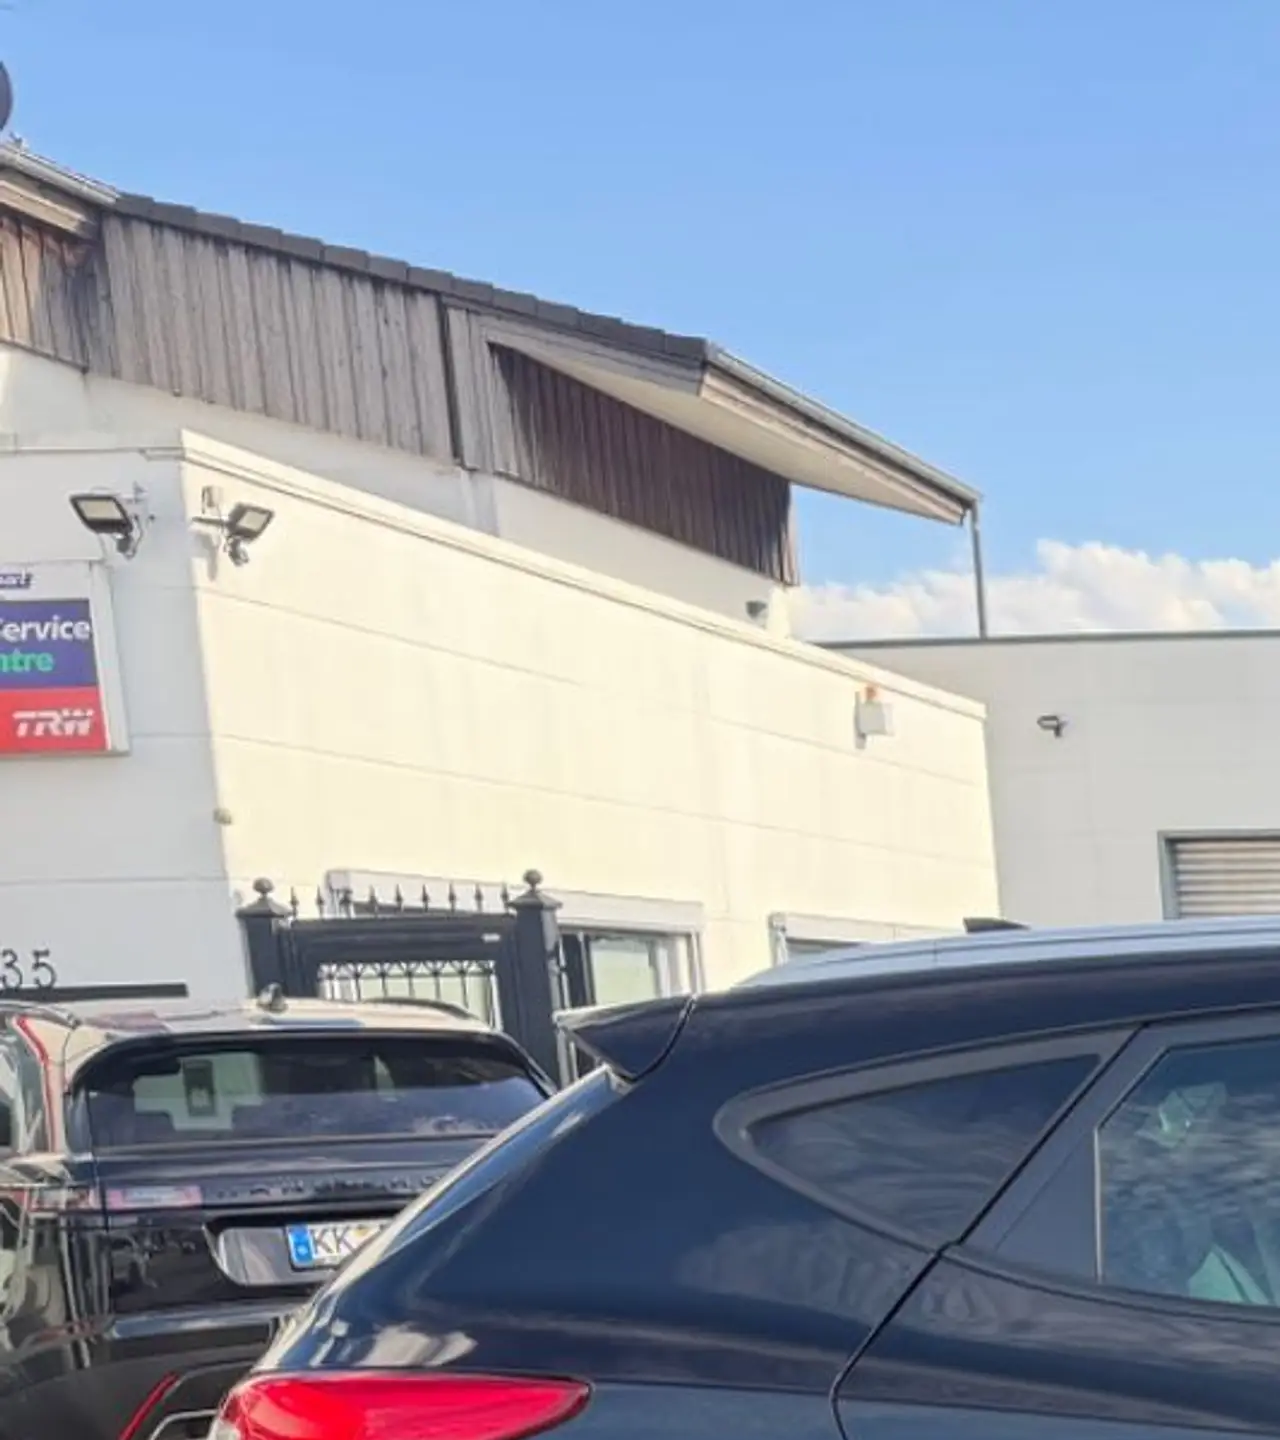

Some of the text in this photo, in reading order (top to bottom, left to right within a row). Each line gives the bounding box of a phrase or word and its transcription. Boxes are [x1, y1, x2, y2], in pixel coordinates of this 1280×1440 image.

[0, 614, 91, 642] ervice
[12, 708, 95, 738] TRW
[1, 948, 57, 989] 35
